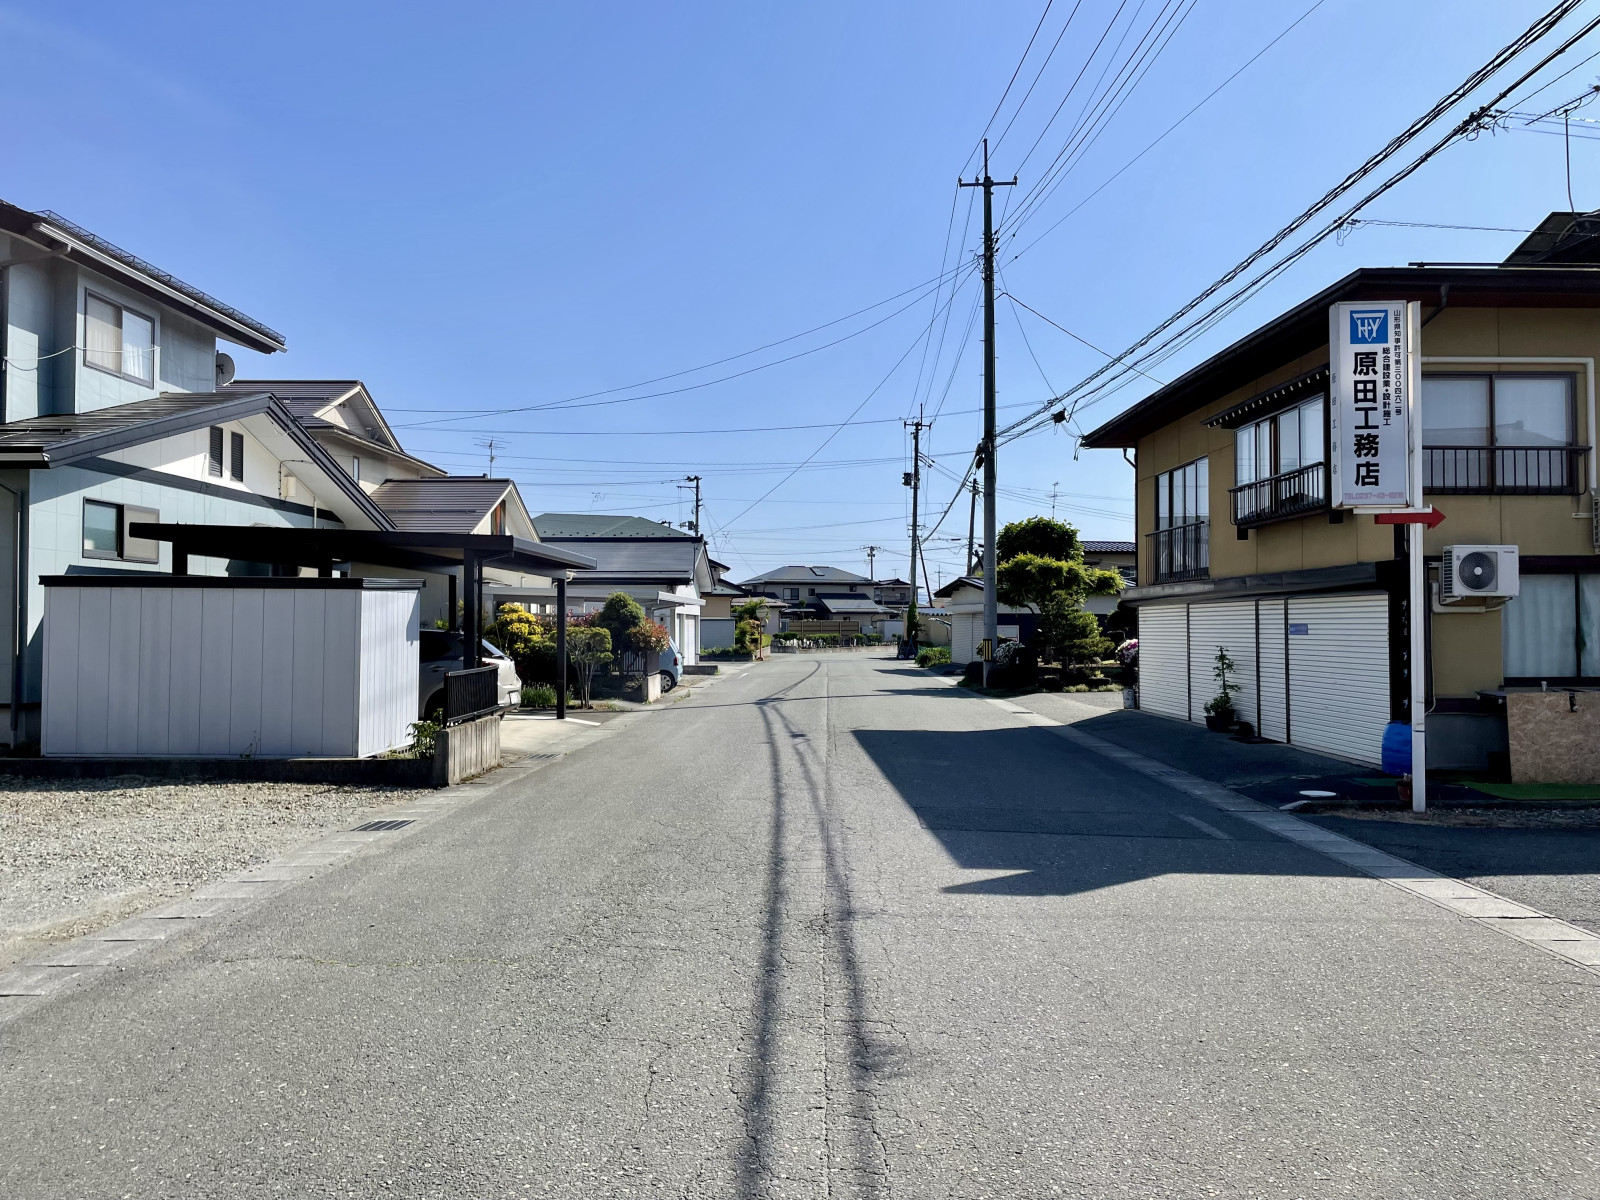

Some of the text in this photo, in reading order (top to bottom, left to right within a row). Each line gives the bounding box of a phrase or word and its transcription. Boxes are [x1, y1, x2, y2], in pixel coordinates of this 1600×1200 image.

[1352, 351, 1380, 487] 原田工務店
